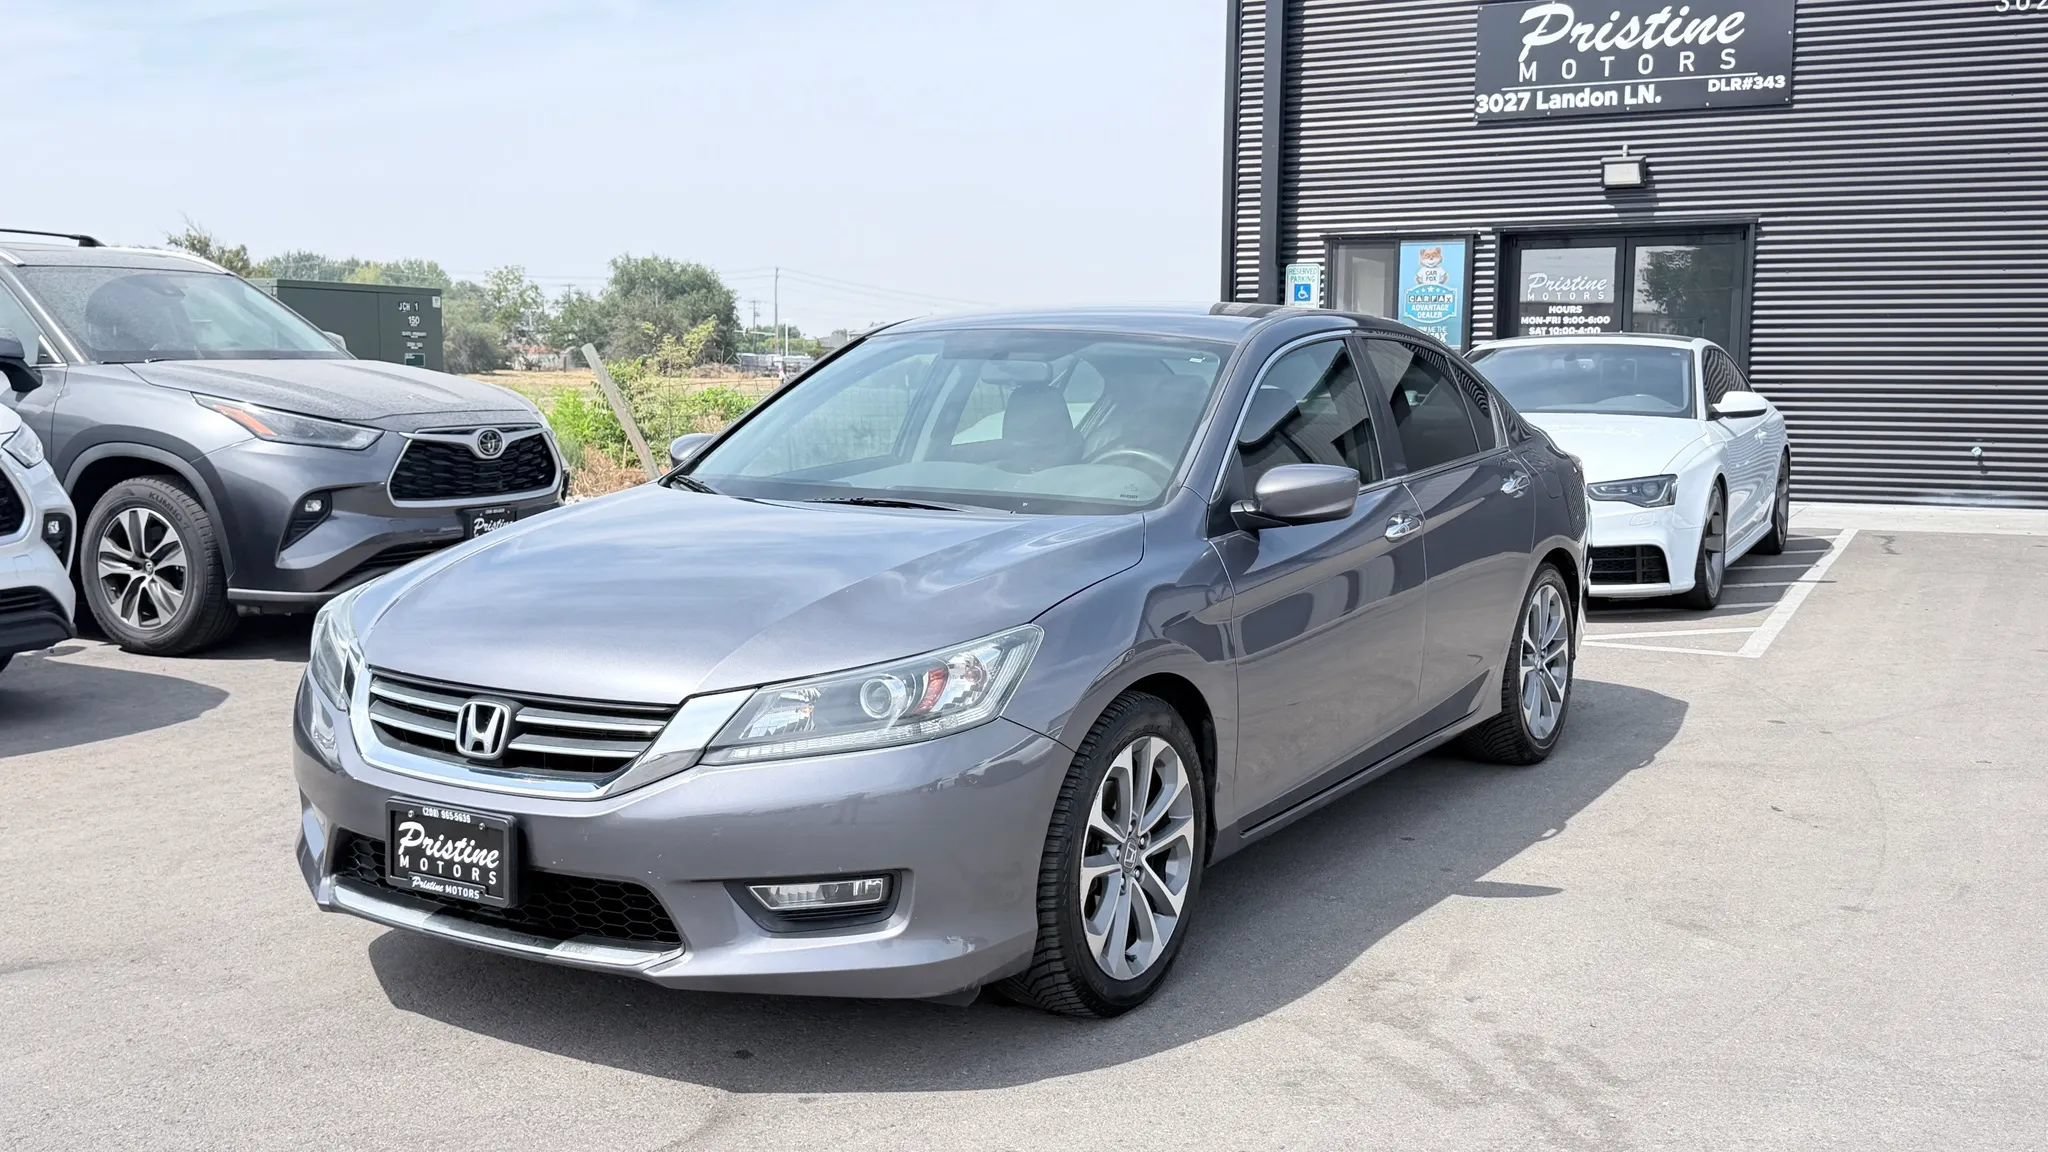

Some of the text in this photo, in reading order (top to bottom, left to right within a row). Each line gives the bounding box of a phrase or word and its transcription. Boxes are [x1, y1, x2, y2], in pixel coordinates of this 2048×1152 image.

[1519, 3, 1745, 62] Pristine
[1519, 48, 1736, 82] MOTORS
[1707, 75, 1786, 93] DLR#343
[1475, 84, 1662, 114] 3027 Landon LN.
[1289, 267, 1317, 276] RESERVED
[1290, 275, 1316, 283] PARKING
[1528, 272, 1608, 293] Pristine
[1409, 294, 1453, 303] CARFAX
[1527, 291, 1605, 301] MOTORS
[1417, 311, 1443, 319] DEALER
[1548, 305, 1583, 314] HOURS
[1520, 315, 1611, 324] MON-FRI 9:00-6:00
[1528, 326, 1547, 336] SAT
[149, 492, 183, 521] KUMHO
[473, 518, 514, 535] Pristi
[398, 821, 500, 868] Pristine
[400, 854, 497, 885] MOTORS
[411, 876, 480, 899] Pristine MOTORS
